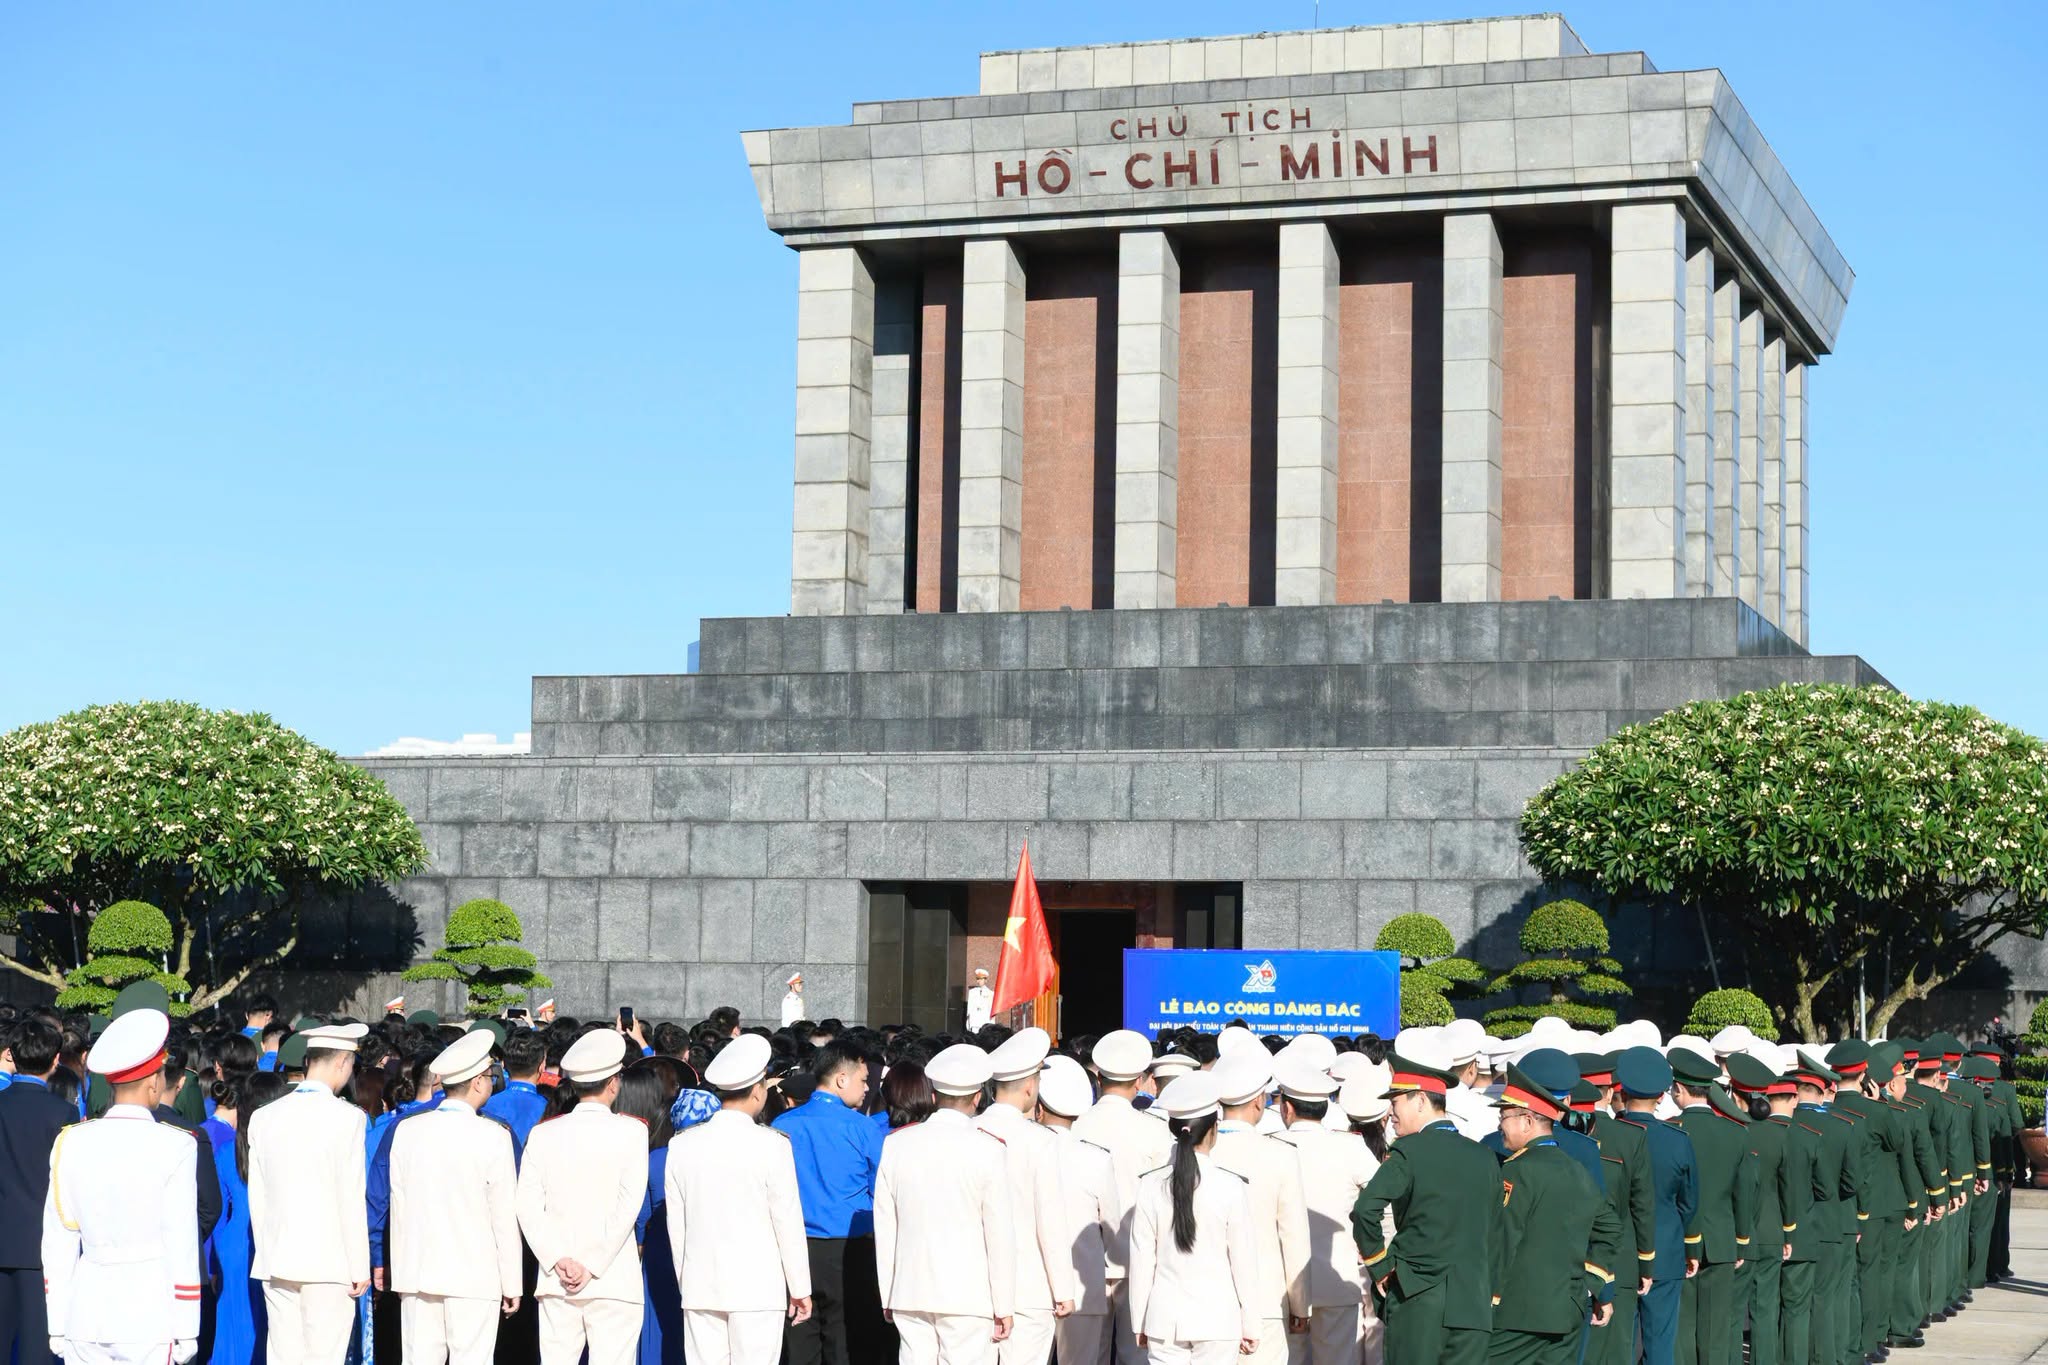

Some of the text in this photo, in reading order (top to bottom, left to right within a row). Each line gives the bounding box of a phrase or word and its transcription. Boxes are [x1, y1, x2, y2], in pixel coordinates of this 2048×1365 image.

[1110, 102, 1311, 142] CHỦ TỊCH
[995, 149, 1073, 198] HỒ
[1125, 139, 1224, 190] CHÍ
[1280, 129, 1438, 181] MINH
